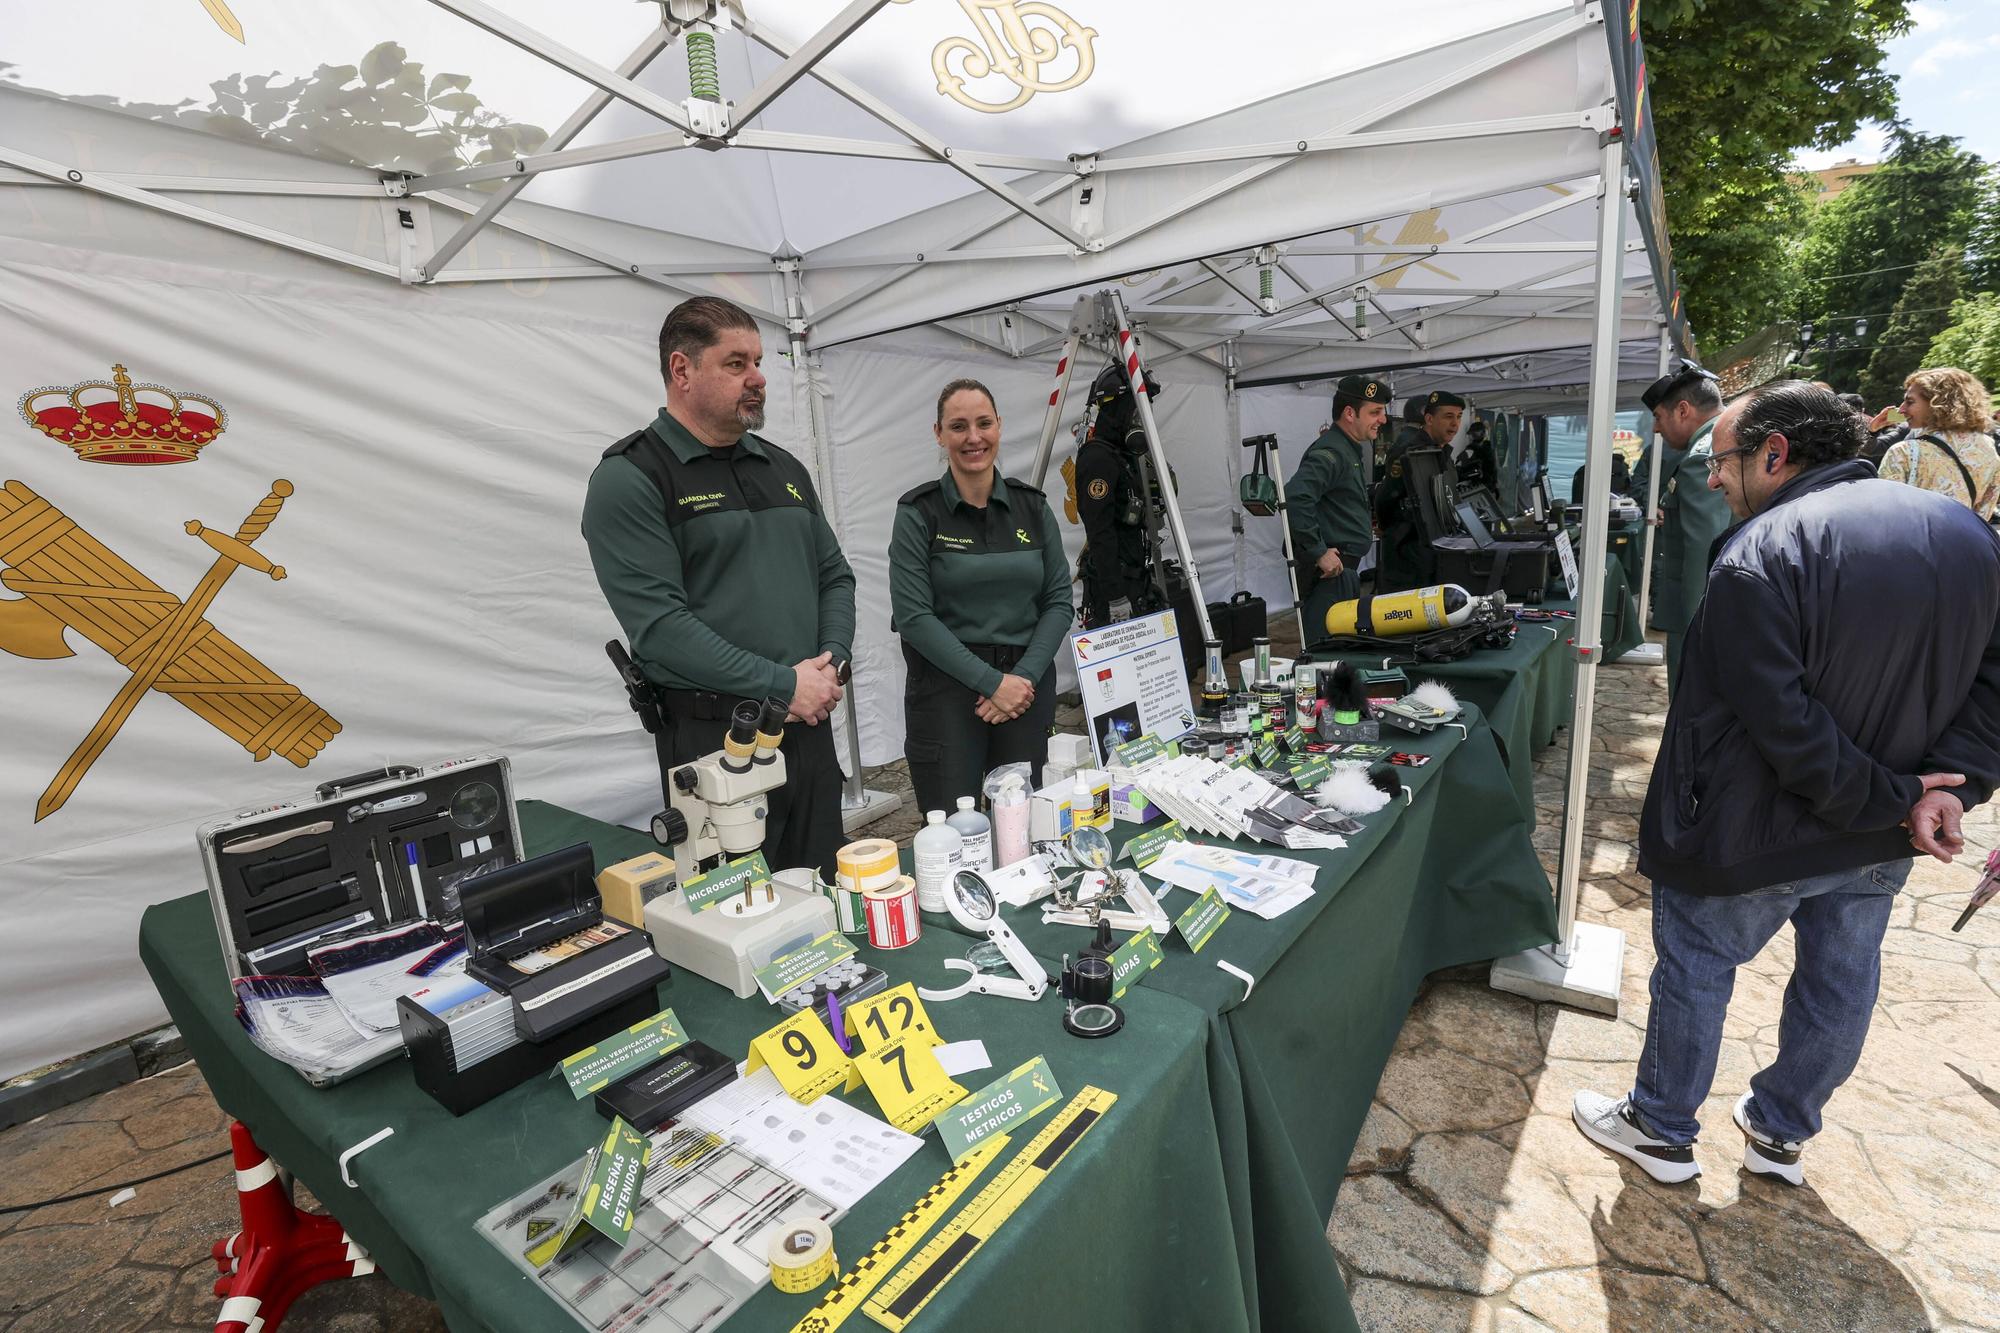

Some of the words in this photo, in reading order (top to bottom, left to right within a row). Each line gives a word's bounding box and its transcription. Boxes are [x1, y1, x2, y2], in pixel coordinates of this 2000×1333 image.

[678, 494, 708, 506] GUARDIA
[935, 534, 959, 543] UARDIA
[1384, 609, 1413, 620] Dräger
[688, 869, 752, 903] MICROSCOPIO
[776, 950, 826, 979] INVESTIGACIÓN
[779, 950, 813, 969] MATERIAL
[783, 976, 794, 984] DE
[794, 956, 829, 978] INCENDIOS
[1113, 954, 1141, 981] LUPAS
[411, 988, 430, 998] 3M
[863, 996, 886, 1009] GUARDIA
[886, 991, 900, 1000] CIVIL
[768, 1024, 789, 1040] GUARDIA
[789, 1017, 803, 1027] CIVIL
[572, 1056, 608, 1078] MATERIAL
[608, 1031, 656, 1058] VERIFICACIÓN
[782, 1030, 817, 1070] 9
[869, 1043, 893, 1059] GUARDIA
[893, 1036, 906, 1046] CIVIL
[570, 1079, 581, 1088] DE
[581, 1053, 630, 1082] DOCUMENTOS
[634, 1036, 664, 1054] BILLETES
[880, 1044, 915, 1095] 7
[959, 1089, 1015, 1127] TESTIGOS
[965, 1102, 1023, 1144] METRICOS
[1019, 1158, 1027, 1166] 20
[600, 1153, 625, 1211] RESEÑAS
[612, 1157, 639, 1228] DETENIDOS
